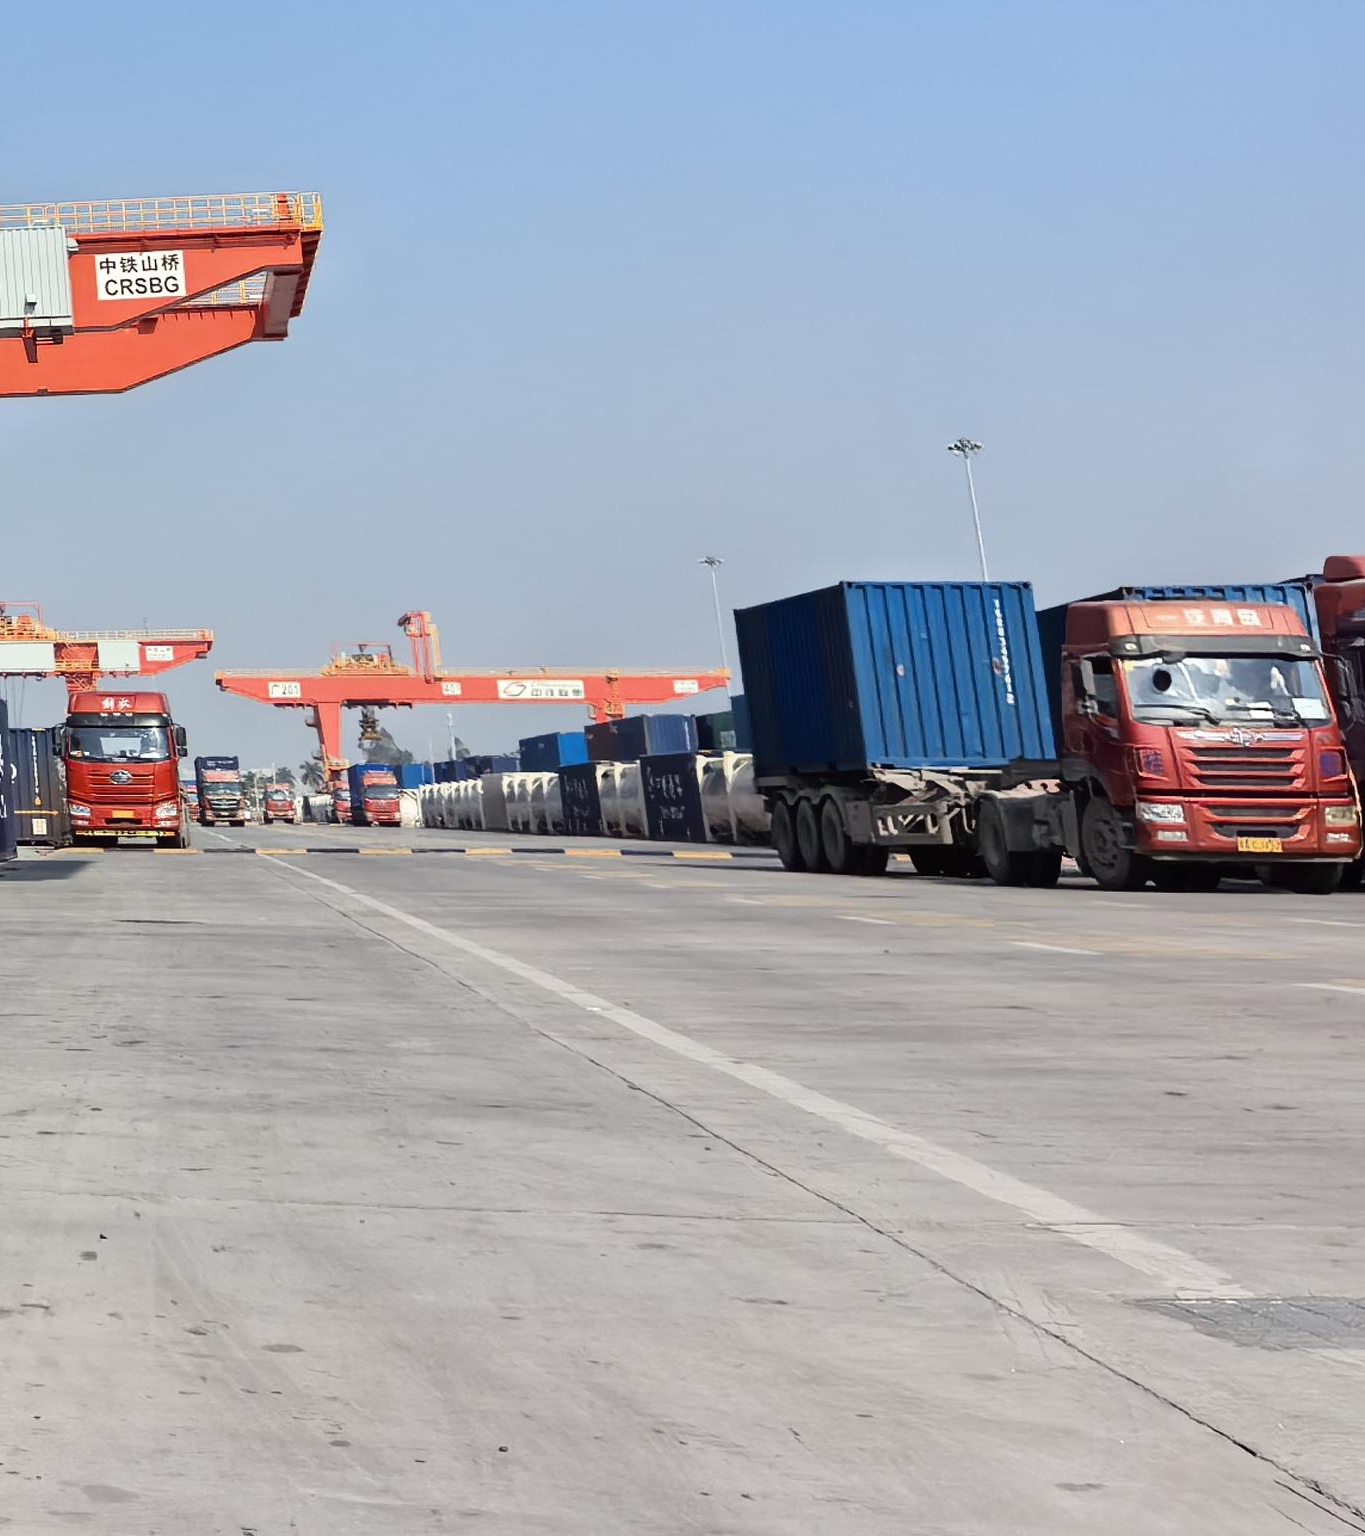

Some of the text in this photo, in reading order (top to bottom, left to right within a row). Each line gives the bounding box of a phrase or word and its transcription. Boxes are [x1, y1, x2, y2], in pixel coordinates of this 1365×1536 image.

[99, 254, 180, 275] 中铁山桥
[104, 275, 180, 296] CRSBG
